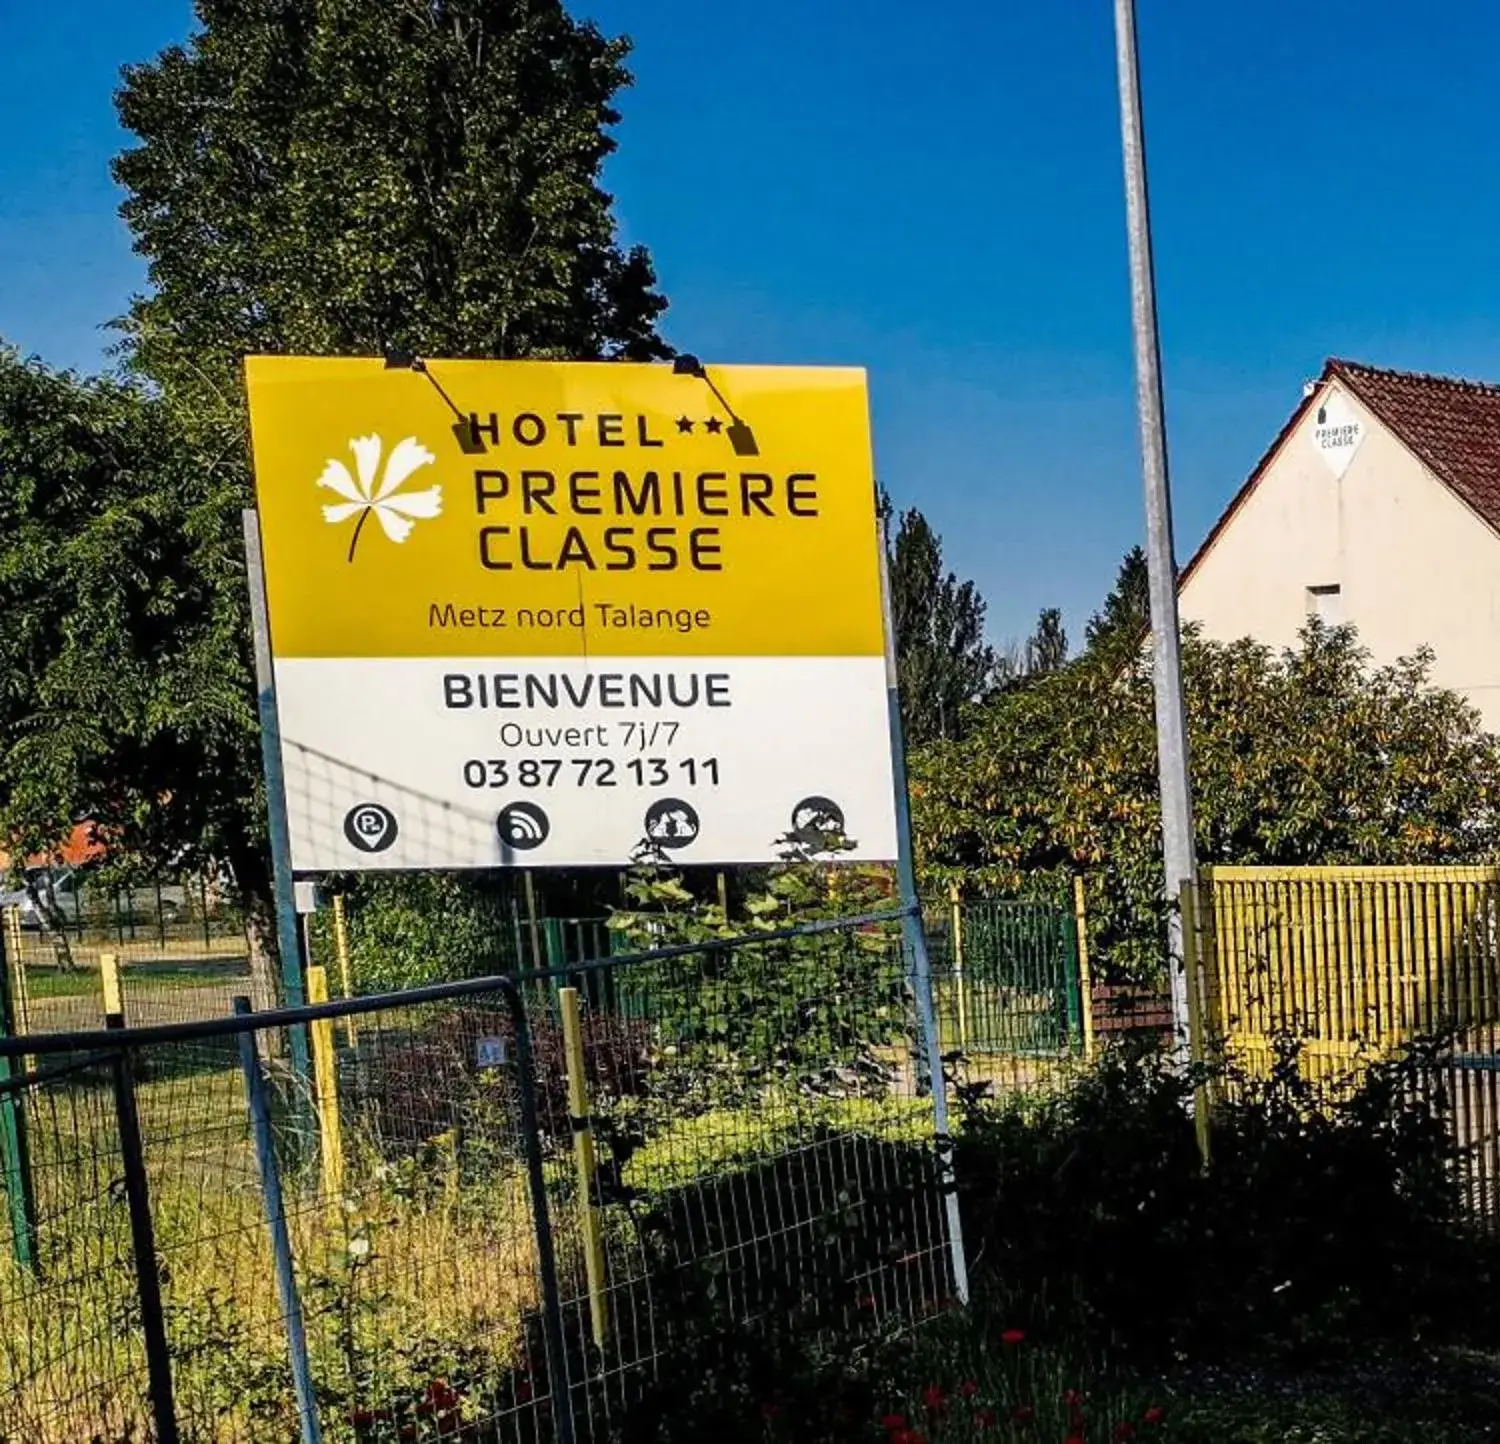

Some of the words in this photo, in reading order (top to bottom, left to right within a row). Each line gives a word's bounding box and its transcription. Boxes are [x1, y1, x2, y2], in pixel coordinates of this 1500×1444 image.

[470, 412, 663, 447] HOTEL
[476, 471, 817, 516] PREMIERE
[480, 527, 721, 570] CLASSE
[430, 604, 505, 626] Metz
[518, 605, 584, 626] nord
[596, 604, 709, 632] Talange
[444, 674, 731, 708] BIENVENUE
[501, 723, 608, 747] Ouvert
[621, 722, 680, 749] 7j/7
[464, 760, 508, 788] 03
[519, 760, 562, 787] 87
[572, 759, 616, 786] 72
[628, 759, 668, 786] 13
[680, 758, 718, 784] 11
